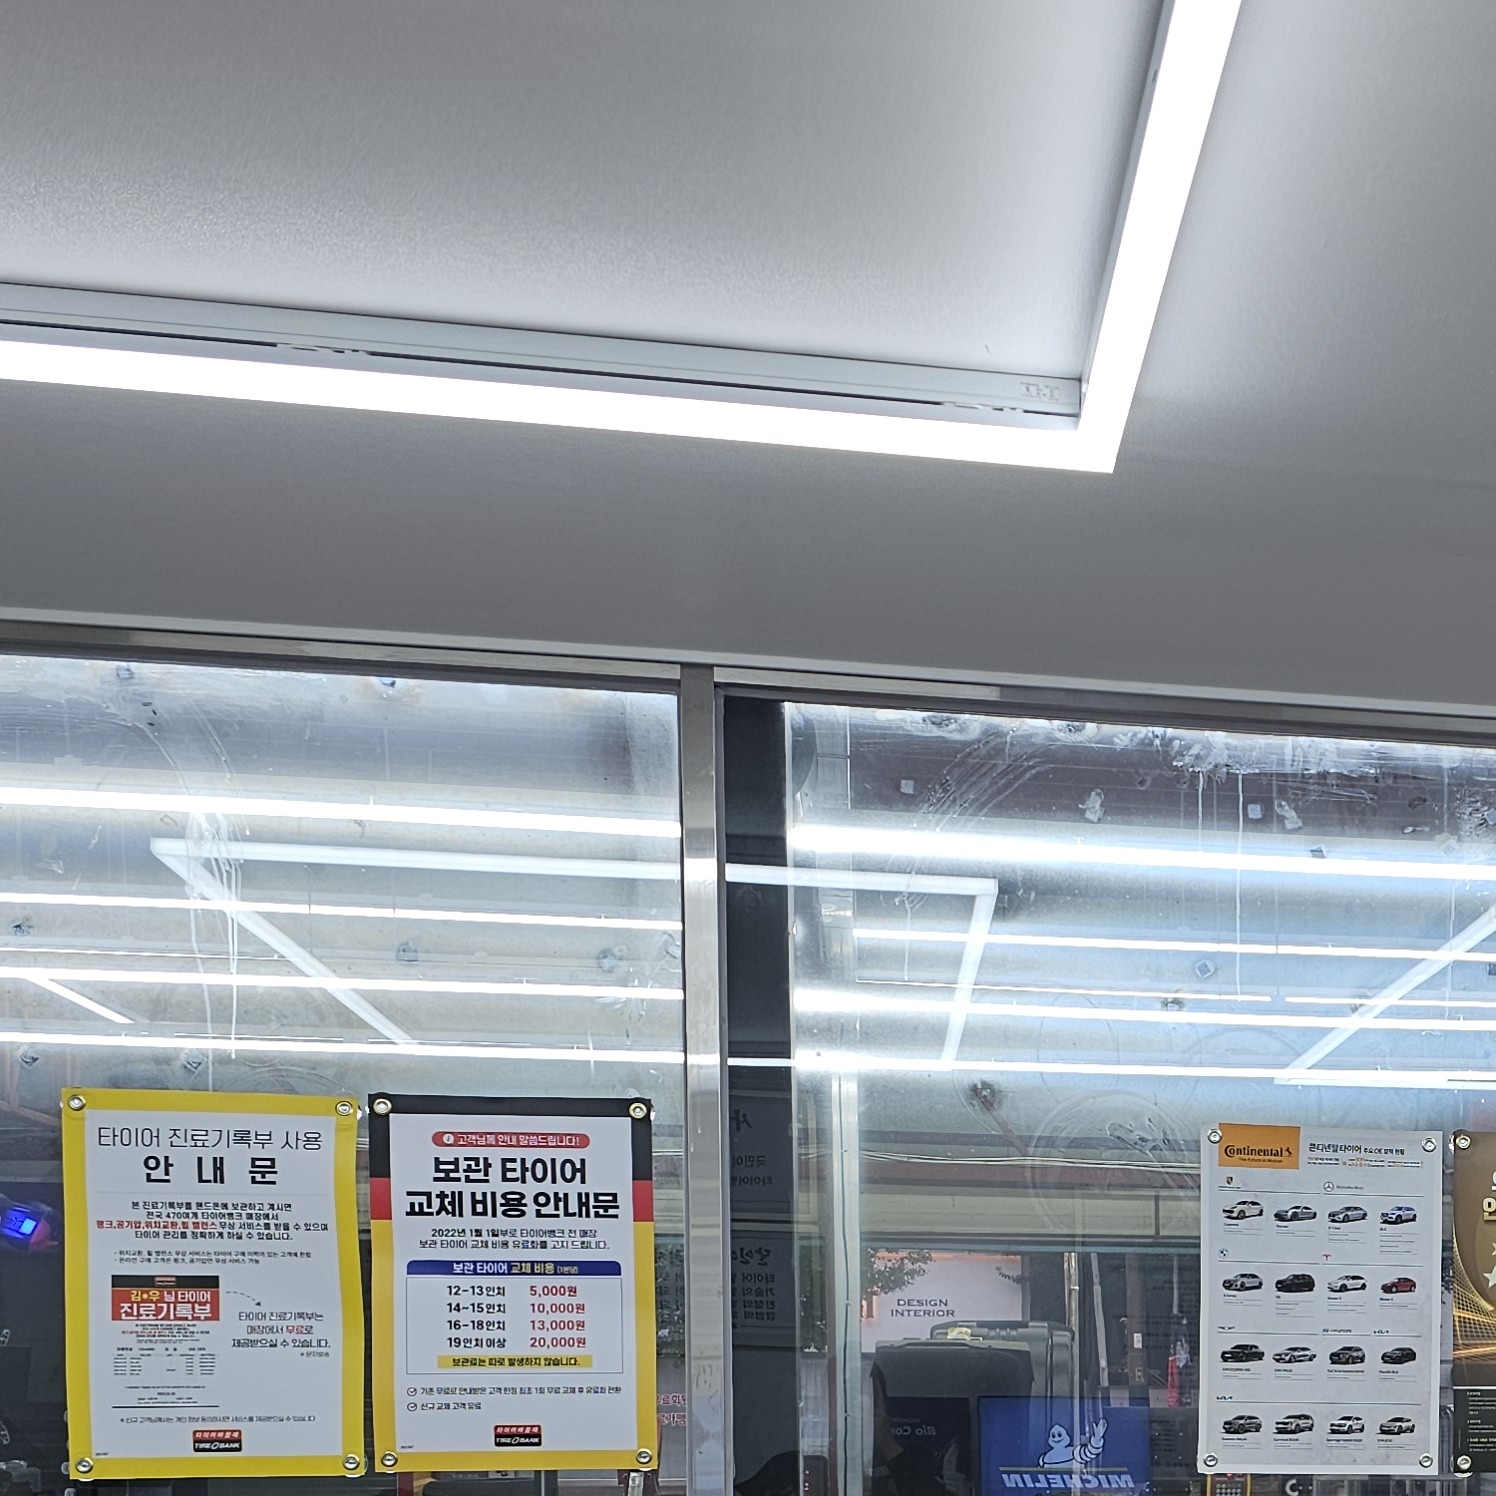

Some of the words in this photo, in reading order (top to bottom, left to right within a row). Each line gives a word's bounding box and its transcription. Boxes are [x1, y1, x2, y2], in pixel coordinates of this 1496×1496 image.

[98, 1127, 160, 1148] 타이어
[169, 1128, 273, 1149] 진료기록부
[281, 1131, 322, 1151] 사용
[497, 1135, 516, 1145] 안내
[1224, 1145, 1284, 1158] Continental
[1340, 1144, 1362, 1154] 타이어
[433, 1157, 492, 1183] 보관
[501, 1158, 586, 1185] 타이어
[142, 1202, 192, 1210] 진료기록부를
[231, 1203, 263, 1211] 보관하고
[267, 1203, 292, 1212] 계시면
[405, 1191, 464, 1218] 교체
[470, 1191, 528, 1218] 비용
[533, 1192, 620, 1219] 안내문
[165, 1212, 198, 1220] 470여개
[246, 1213, 278, 1221] 매장에서
[219, 1222, 235, 1230] 무상
[238, 1222, 270, 1230] 서비스를
[274, 1222, 290, 1230] 받을
[304, 1223, 328, 1231] 있으며
[135, 1230, 159, 1239] 타이어
[163, 1231, 187, 1239] 관리를
[228, 1232, 242, 1240] 하실
[246, 1232, 253, 1240] 수
[257, 1232, 293, 1240] 있습니다.
[431, 1229, 466, 1238] 2022년
[470, 1230, 482, 1238] 1월
[520, 1230, 564, 1238] 타이어뱅크
[567, 1230, 576, 1238] 전
[579, 1230, 597, 1238] 매장
[420, 1240, 437, 1249] 보관
[441, 1240, 467, 1249] 타이어
[471, 1240, 488, 1249] 교체
[491, 1240, 509, 1249] 비용
[551, 1240, 568, 1249] 고지
[571, 1240, 609, 1250] 드립니다.
[452, 1263, 474, 1274] 보관
[476, 1263, 508, 1274] 타이어
[511, 1263, 531, 1274] 교체
[534, 1263, 554, 1274] 비용
[164, 1291, 174, 1301] 님
[178, 1291, 210, 1302] 타이어
[529, 1286, 577, 1297] 5,000원
[897, 1299, 948, 1307] DESIGN
[120, 1303, 211, 1320] 진료기록부
[530, 1303, 585, 1314] 10,000원
[891, 1309, 955, 1317] INTERIOR
[239, 1312, 266, 1321] 타이어
[269, 1311, 324, 1321] 진료기록부는
[247, 1325, 283, 1335] 매장에서
[286, 1325, 313, 1334] 무료로
[530, 1320, 585, 1332] 13,000원
[232, 1339, 278, 1348] 제공받으실
[280, 1339, 289, 1348] 수
[292, 1339, 331, 1348] 있습니다.
[486, 1338, 506, 1348] 이상
[530, 1338, 586, 1349] 20,000원
[452, 1358, 486, 1367] 보관료는
[489, 1358, 505, 1366] 따로
[508, 1358, 541, 1366] 발생하지
